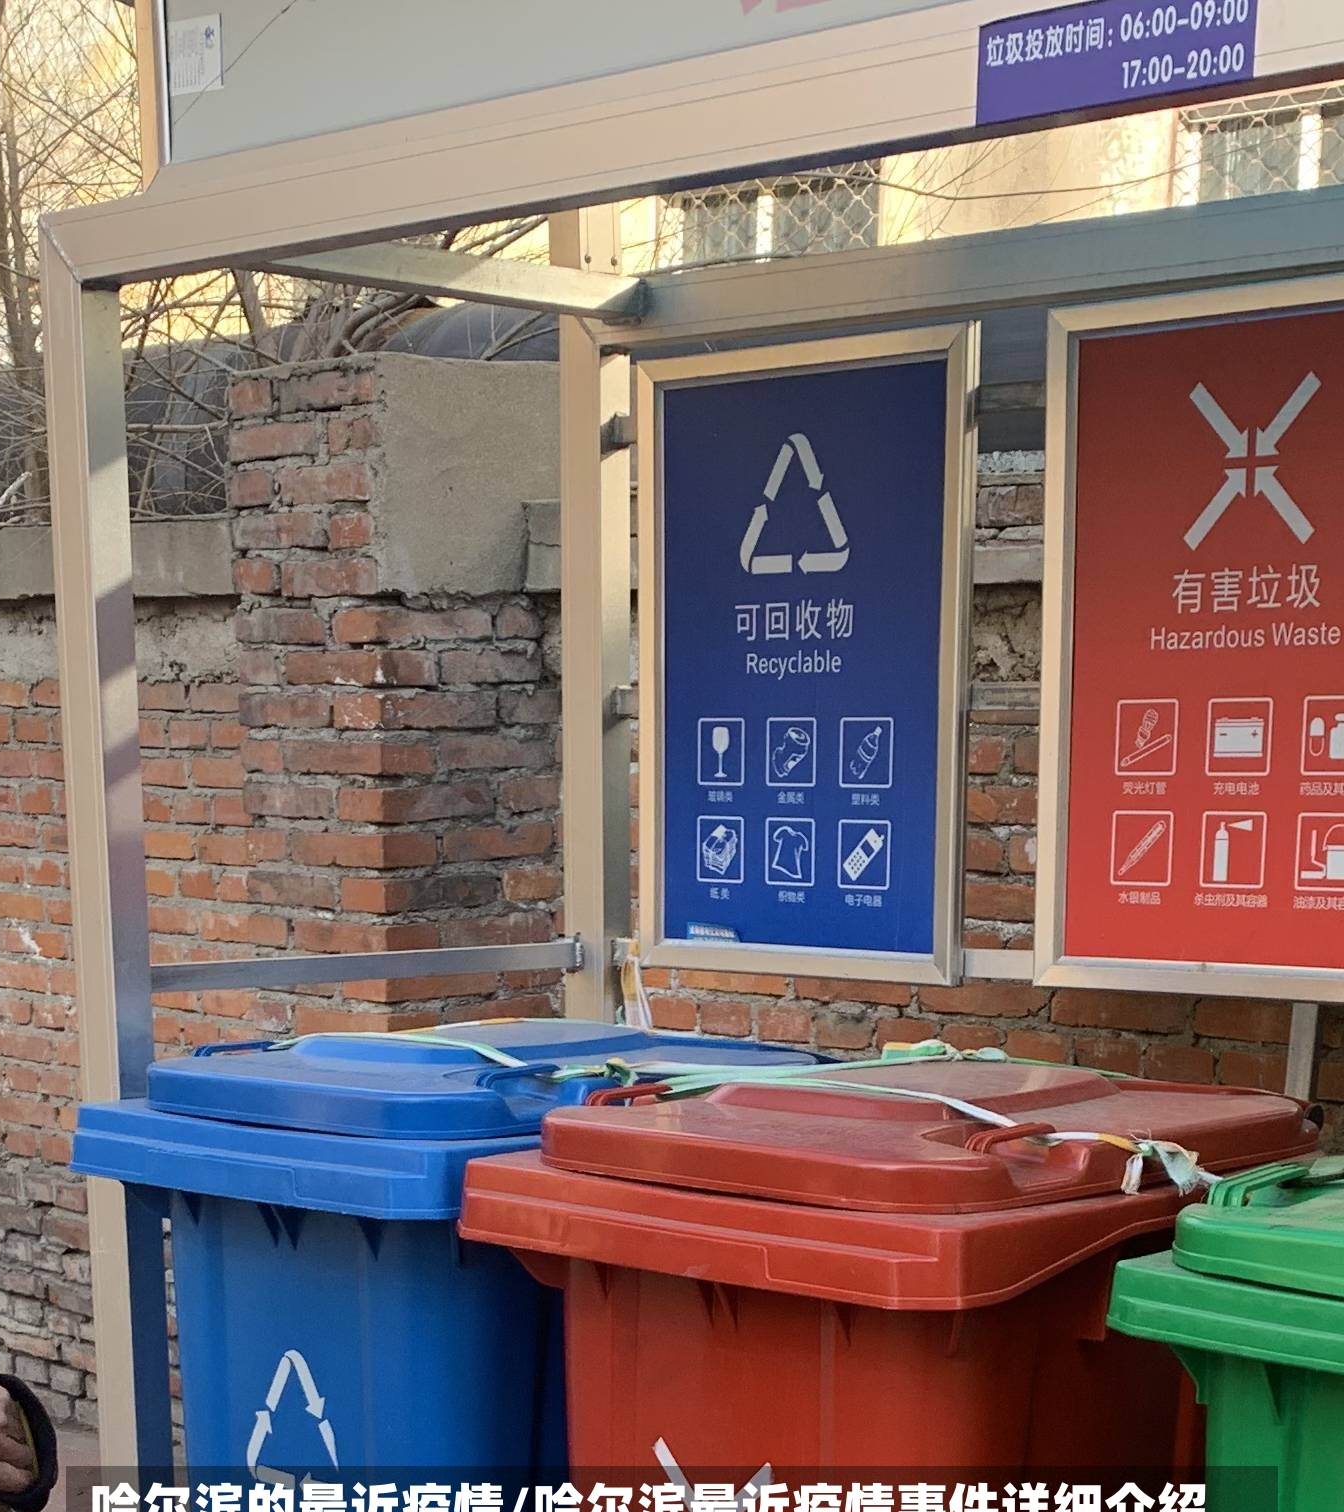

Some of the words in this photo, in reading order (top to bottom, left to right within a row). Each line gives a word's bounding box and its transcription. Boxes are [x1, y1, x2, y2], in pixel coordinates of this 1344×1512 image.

[1122, 43, 1245, 89] 17:00-20:00
[1172, 563, 1321, 614] 有害垃圾
[735, 598, 854, 641] 可回收物
[1150, 625, 1265, 650] Hazardous
[1272, 622, 1342, 646] Waste
[746, 649, 842, 680] Recyclable
[1213, 782, 1260, 796] 充电电池
